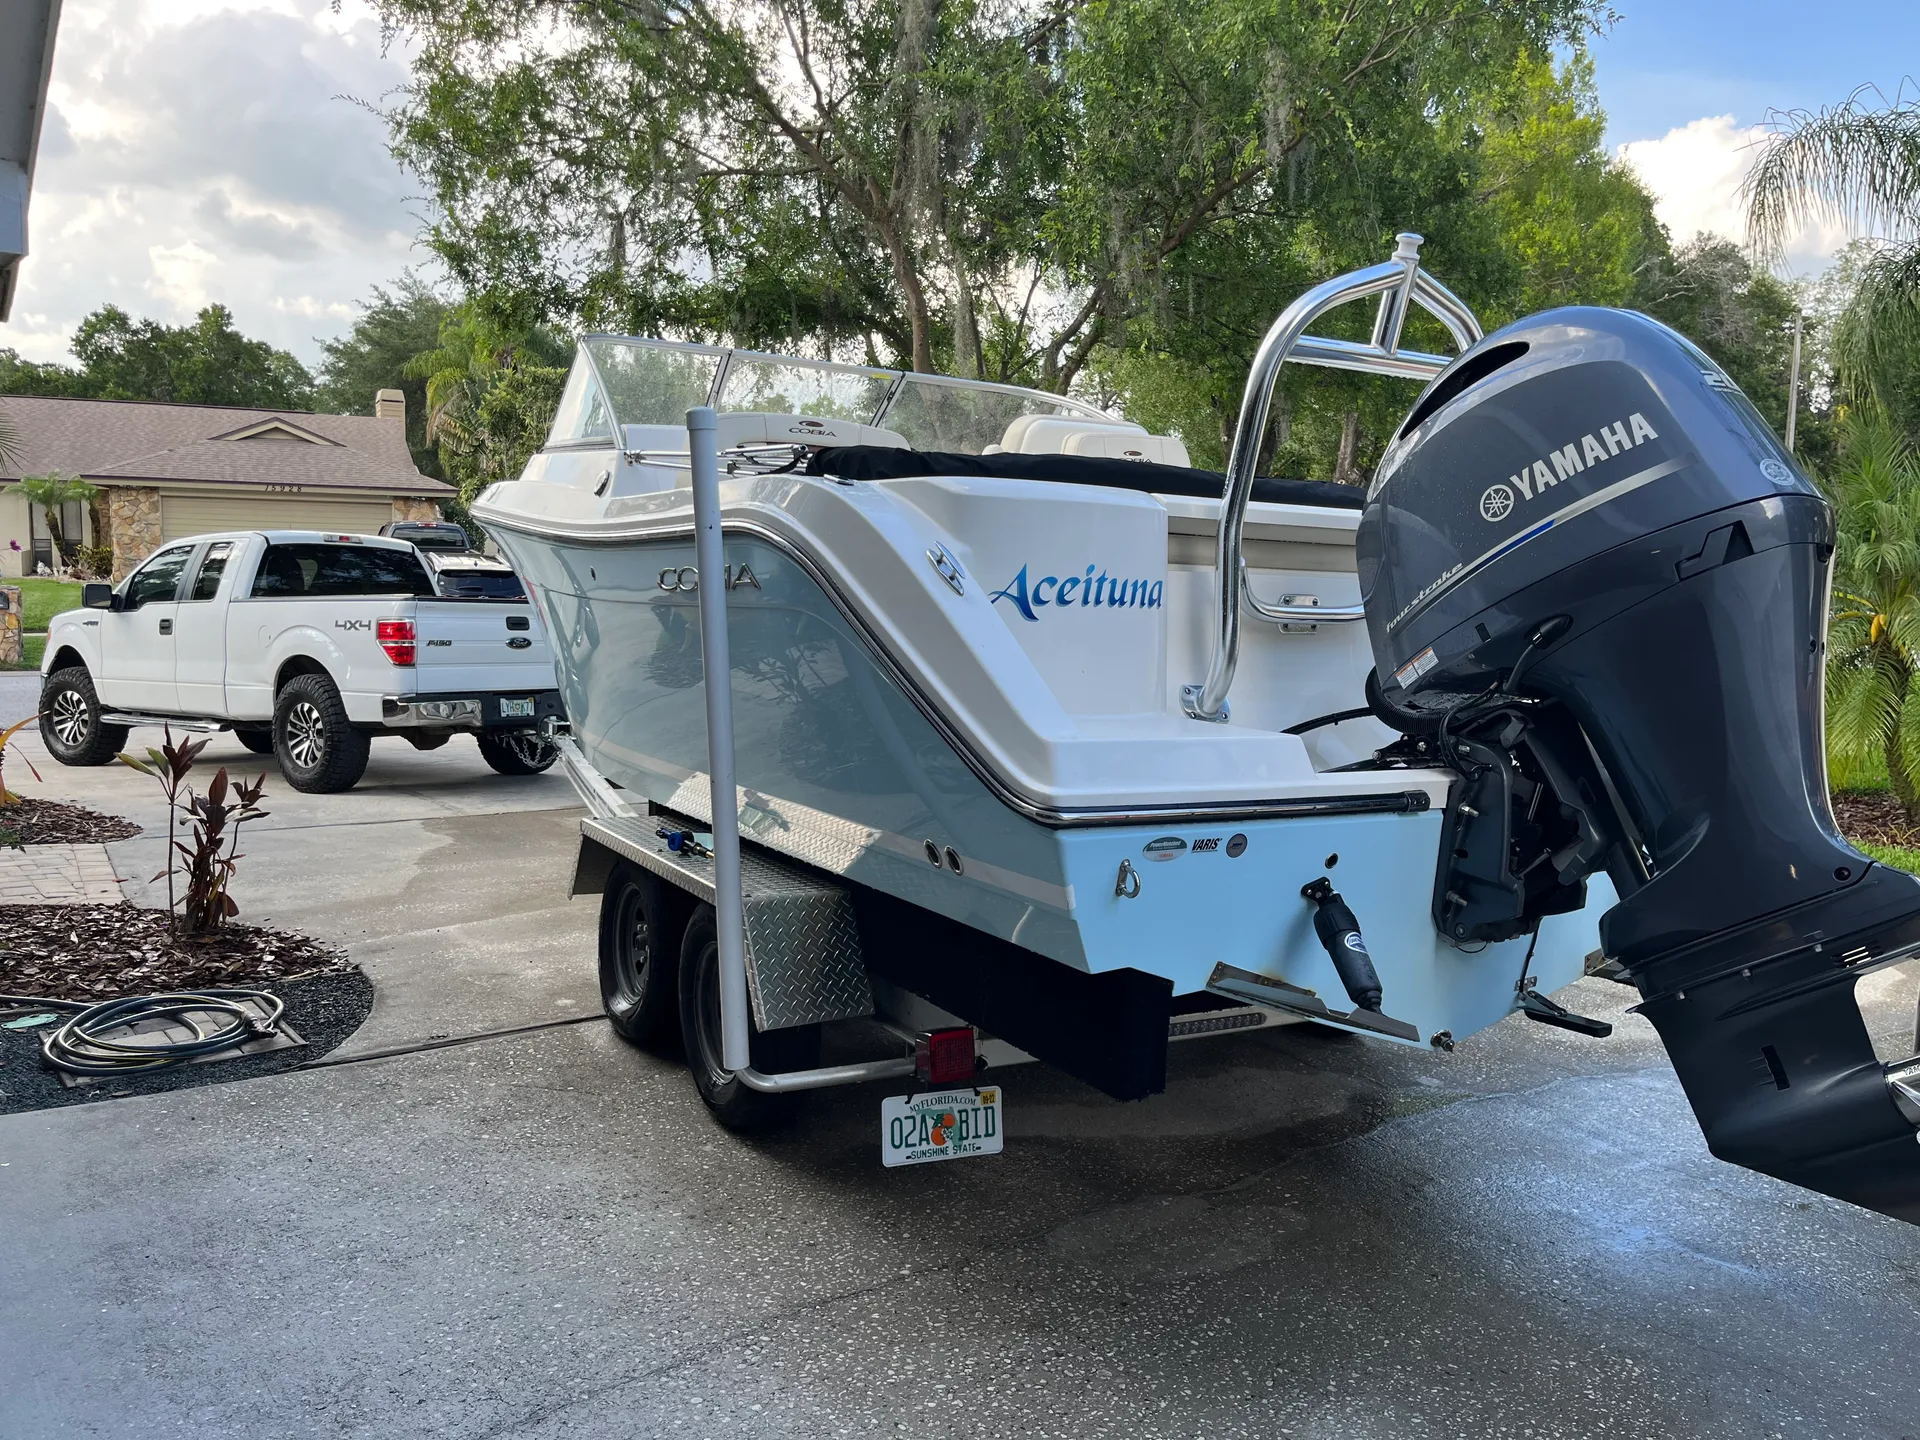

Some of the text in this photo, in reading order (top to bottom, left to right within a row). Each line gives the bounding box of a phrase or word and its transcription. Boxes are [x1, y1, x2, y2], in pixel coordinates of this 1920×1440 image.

[788, 427, 837, 438] COBIA
[1509, 412, 1659, 501] YAMAHA
[265, 484, 302, 492] 15928
[657, 563, 762, 592] COIA
[987, 562, 1164, 622] Aceituna
[909, 1094, 977, 1114] MYFLORIDA.COM
[910, 1142, 977, 1160] SUNSHINE STATE
